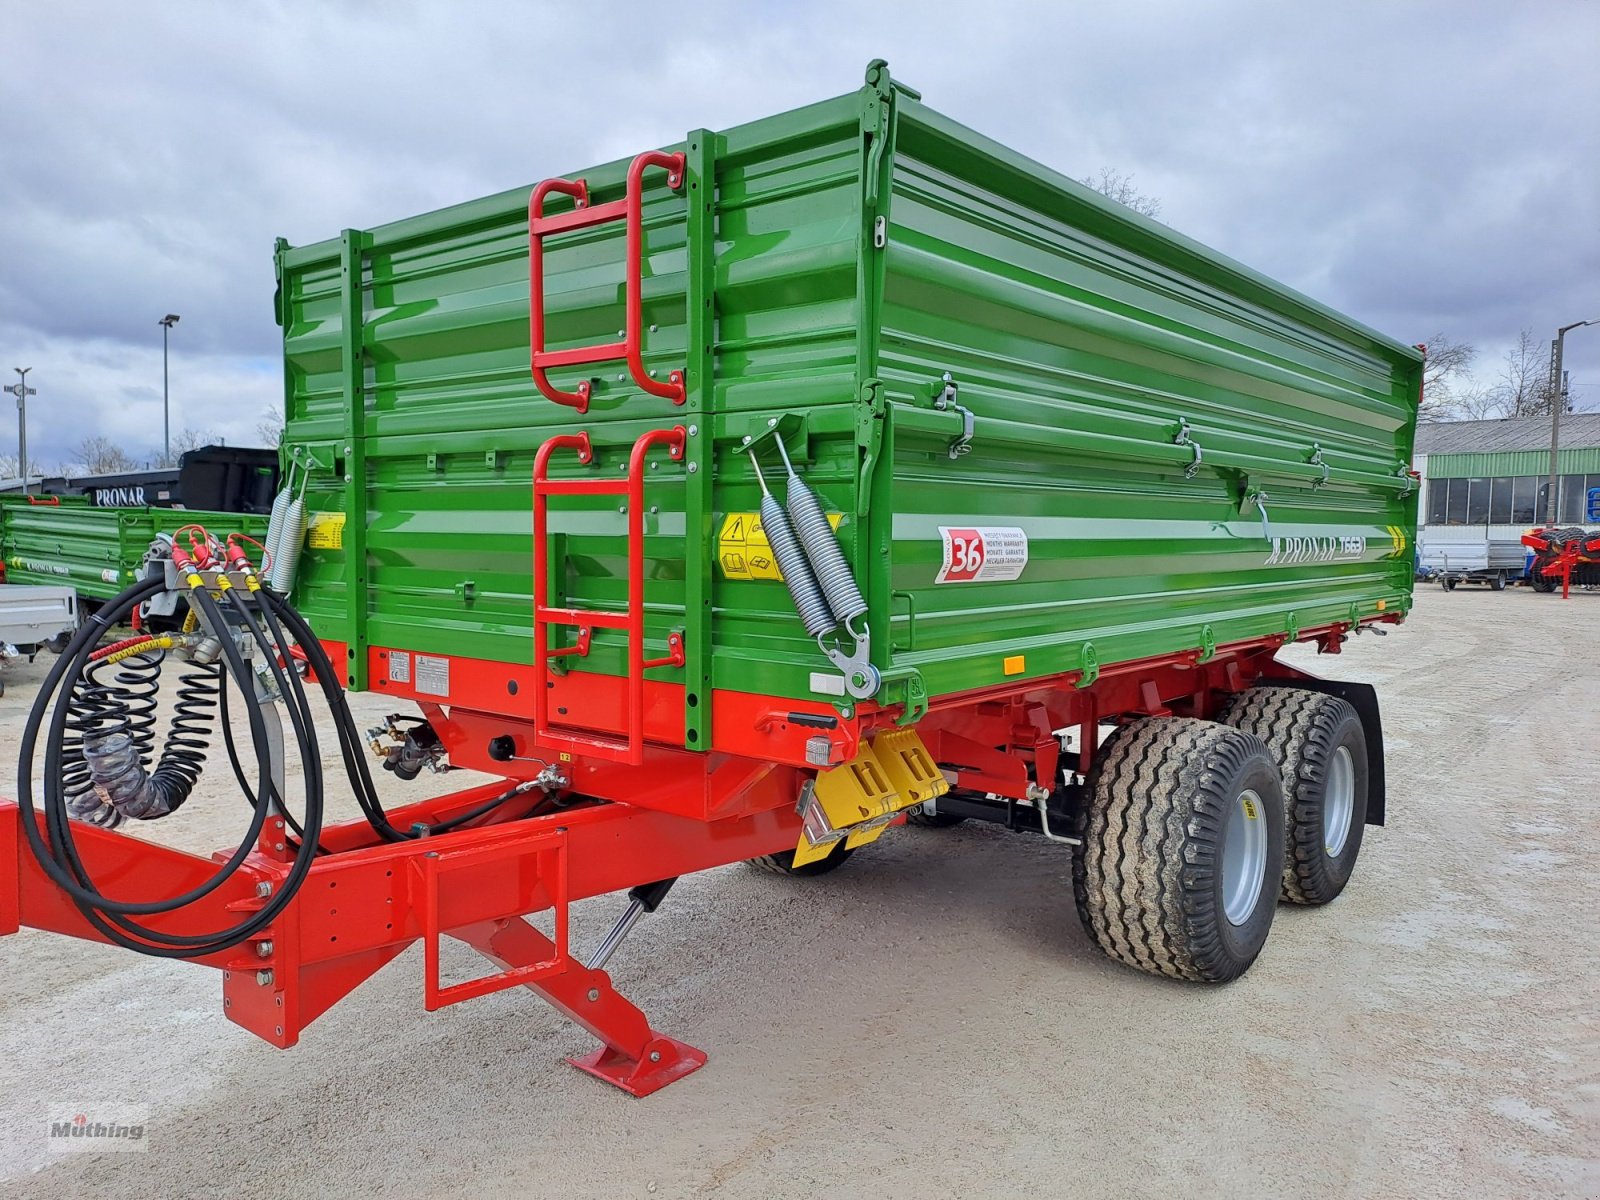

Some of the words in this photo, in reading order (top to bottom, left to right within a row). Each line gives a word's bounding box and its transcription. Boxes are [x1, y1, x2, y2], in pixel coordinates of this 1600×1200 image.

[96, 487, 147, 507] PRONAR
[950, 538, 981, 573] 36
[1279, 536, 1336, 564] PRONAR
